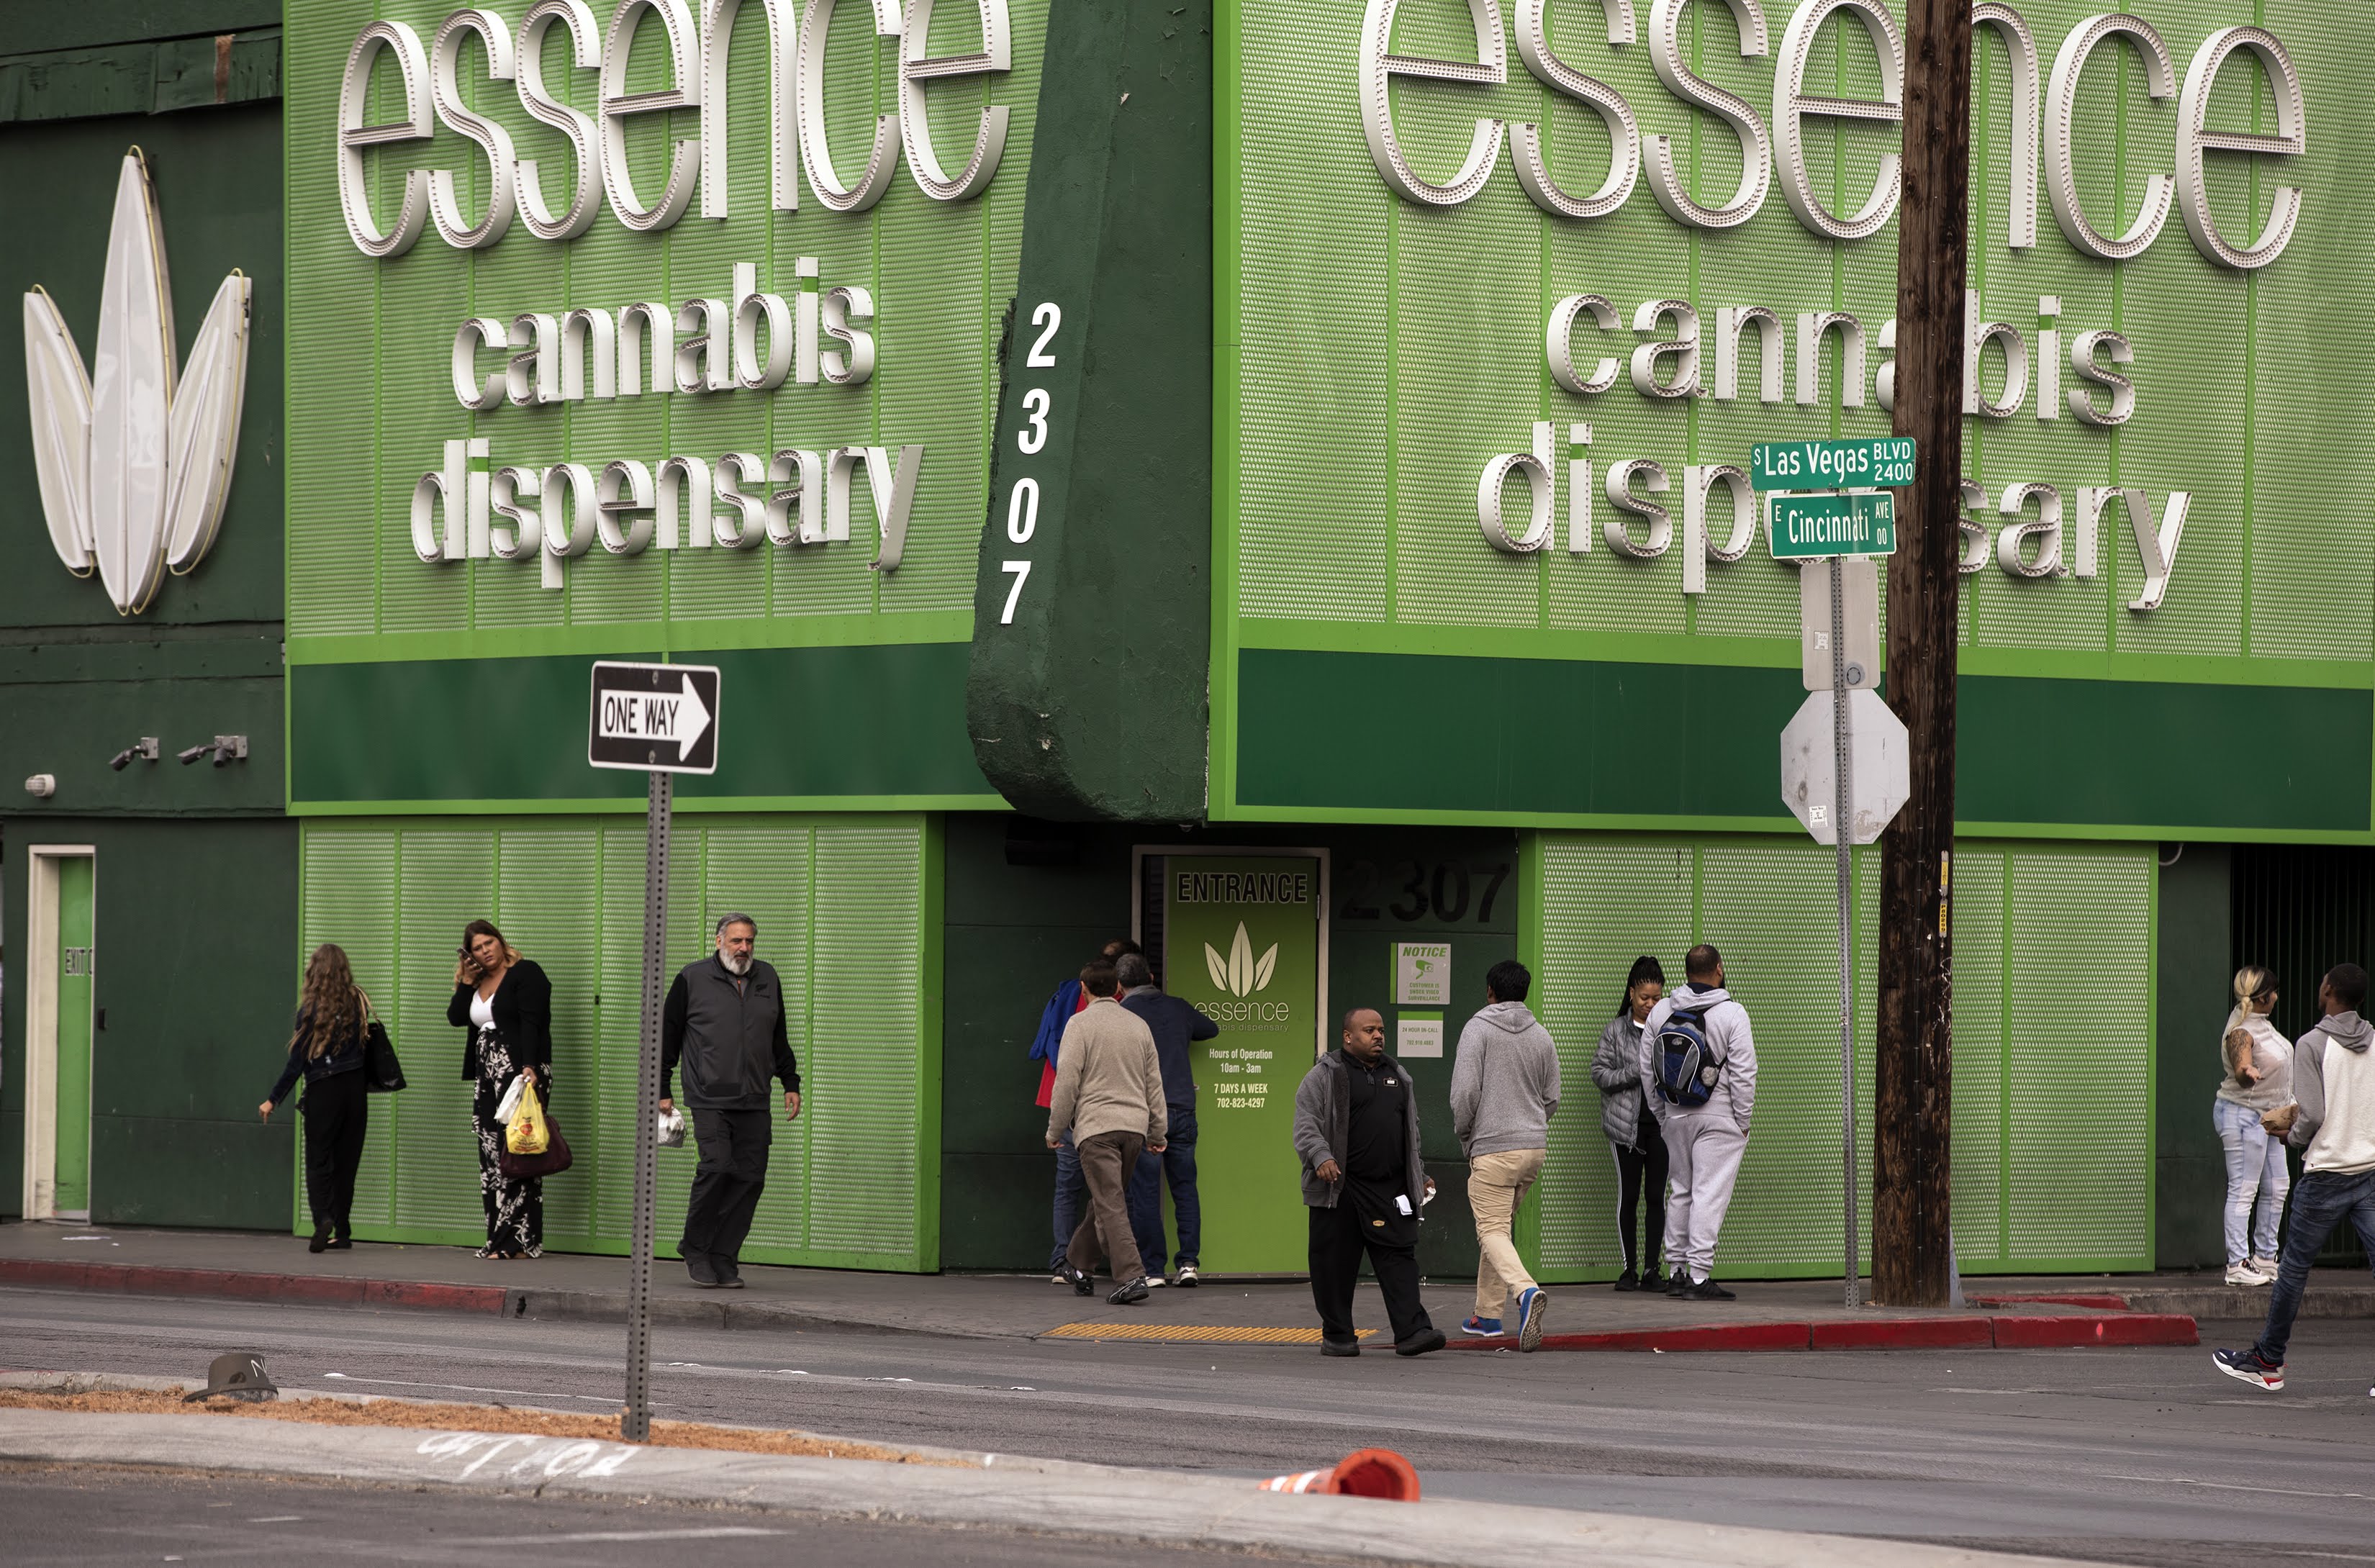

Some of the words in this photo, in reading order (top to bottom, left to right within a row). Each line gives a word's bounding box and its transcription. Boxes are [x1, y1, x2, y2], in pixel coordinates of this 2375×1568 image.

[339, 0, 1010, 256] essence
[1359, 0, 2305, 268] essence
[453, 257, 874, 409] cannabis
[1754, 448, 1761, 466] S
[1765, 445, 1800, 476] Las
[1806, 443, 1868, 484] Vegas
[1873, 442, 1911, 460] BLVD
[1874, 463, 1913, 481] 2400
[411, 438, 923, 589] dispensary
[1775, 505, 1782, 522] E
[1788, 507, 1869, 544] Cincinnati
[1876, 502, 1889, 519] AVE
[1876, 527, 1887, 545] 00
[605, 696, 638, 734] ONE
[645, 698, 679, 736] WAY
[1177, 872, 1308, 904] ENTRANCE
[1339, 858, 1511, 923] 2307
[65, 946, 85, 976] EXIT
[1403, 946, 1447, 957] NOTICE
[1194, 1002, 1289, 1021] essence
[1239, 1023, 1289, 1032] dispensary
[1210, 1048, 1229, 1059] Hours
[1231, 1048, 1238, 1059] of
[1239, 1048, 1272, 1061] Operation
[1221, 1063, 1239, 1073] 10am
[1247, 1064, 1261, 1073] 3am
[1214, 1084, 1218, 1094] 7
[1221, 1084, 1239, 1094] DAYS
[1241, 1084, 1246, 1094] A
[1248, 1084, 1268, 1094] WEEK
[1217, 1097, 1265, 1108] 702-823-4297
